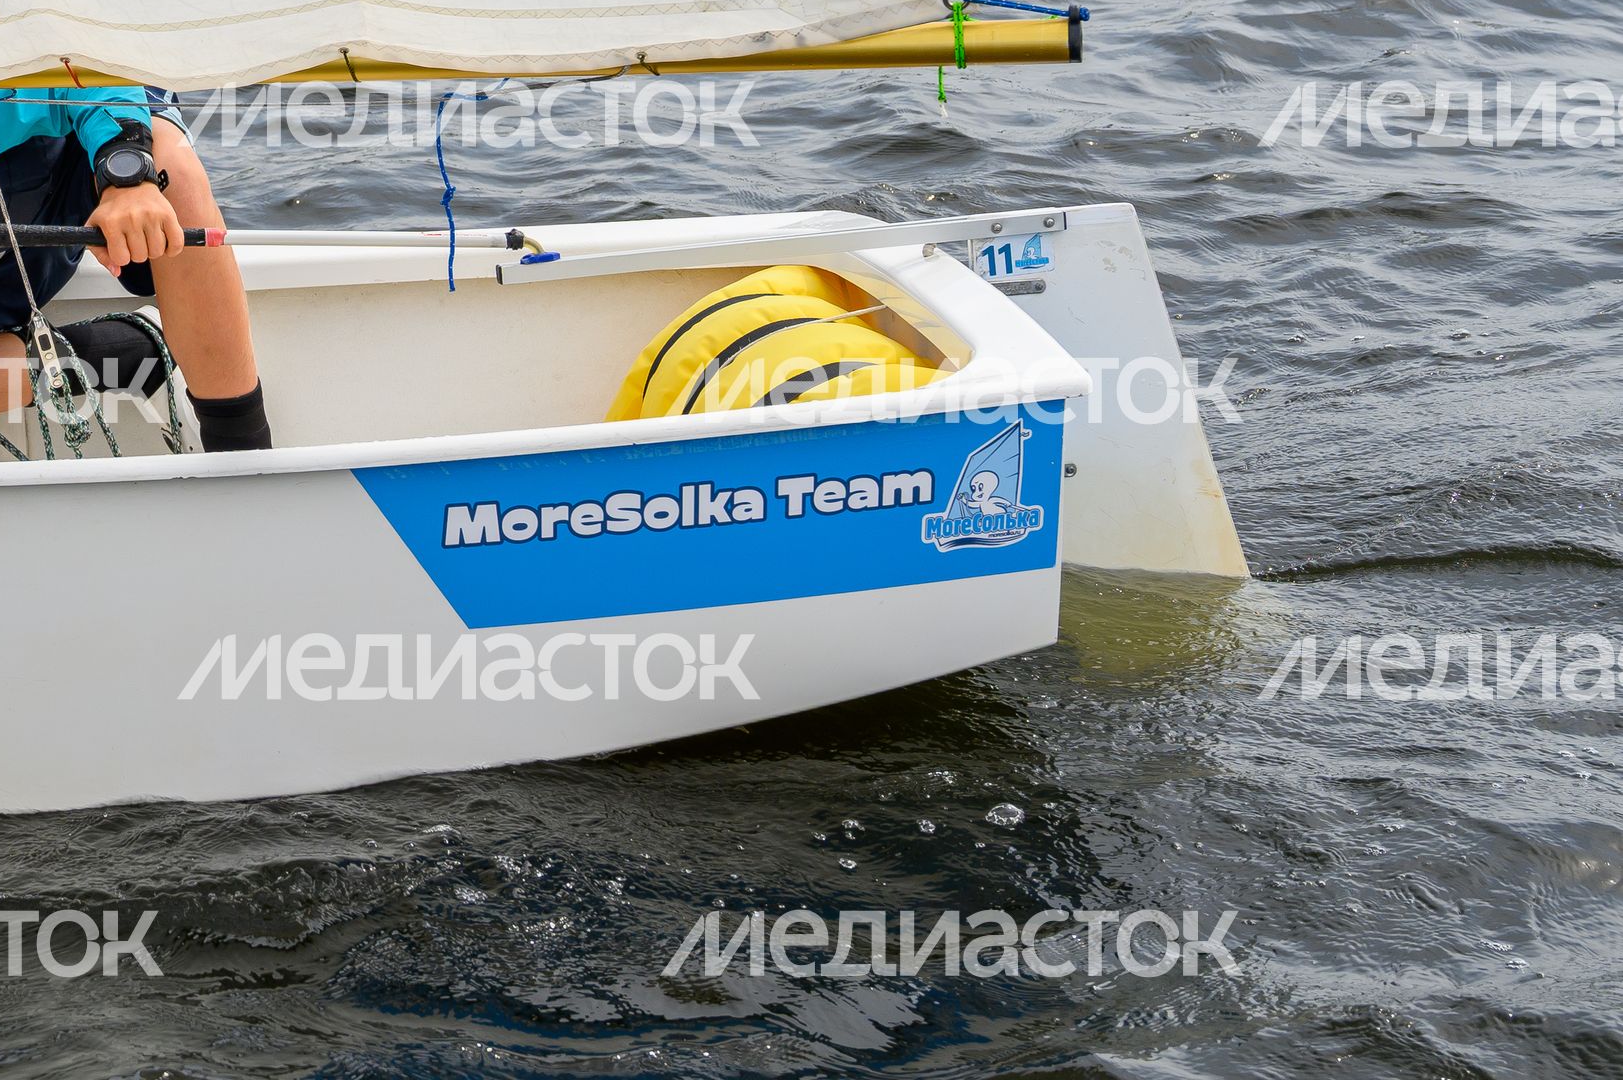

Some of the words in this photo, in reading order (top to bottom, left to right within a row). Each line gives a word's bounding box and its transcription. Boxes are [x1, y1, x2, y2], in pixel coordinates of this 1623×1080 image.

[981, 242, 1014, 277] 11
[442, 483, 766, 547] MoreSolka
[776, 470, 934, 517] Team
